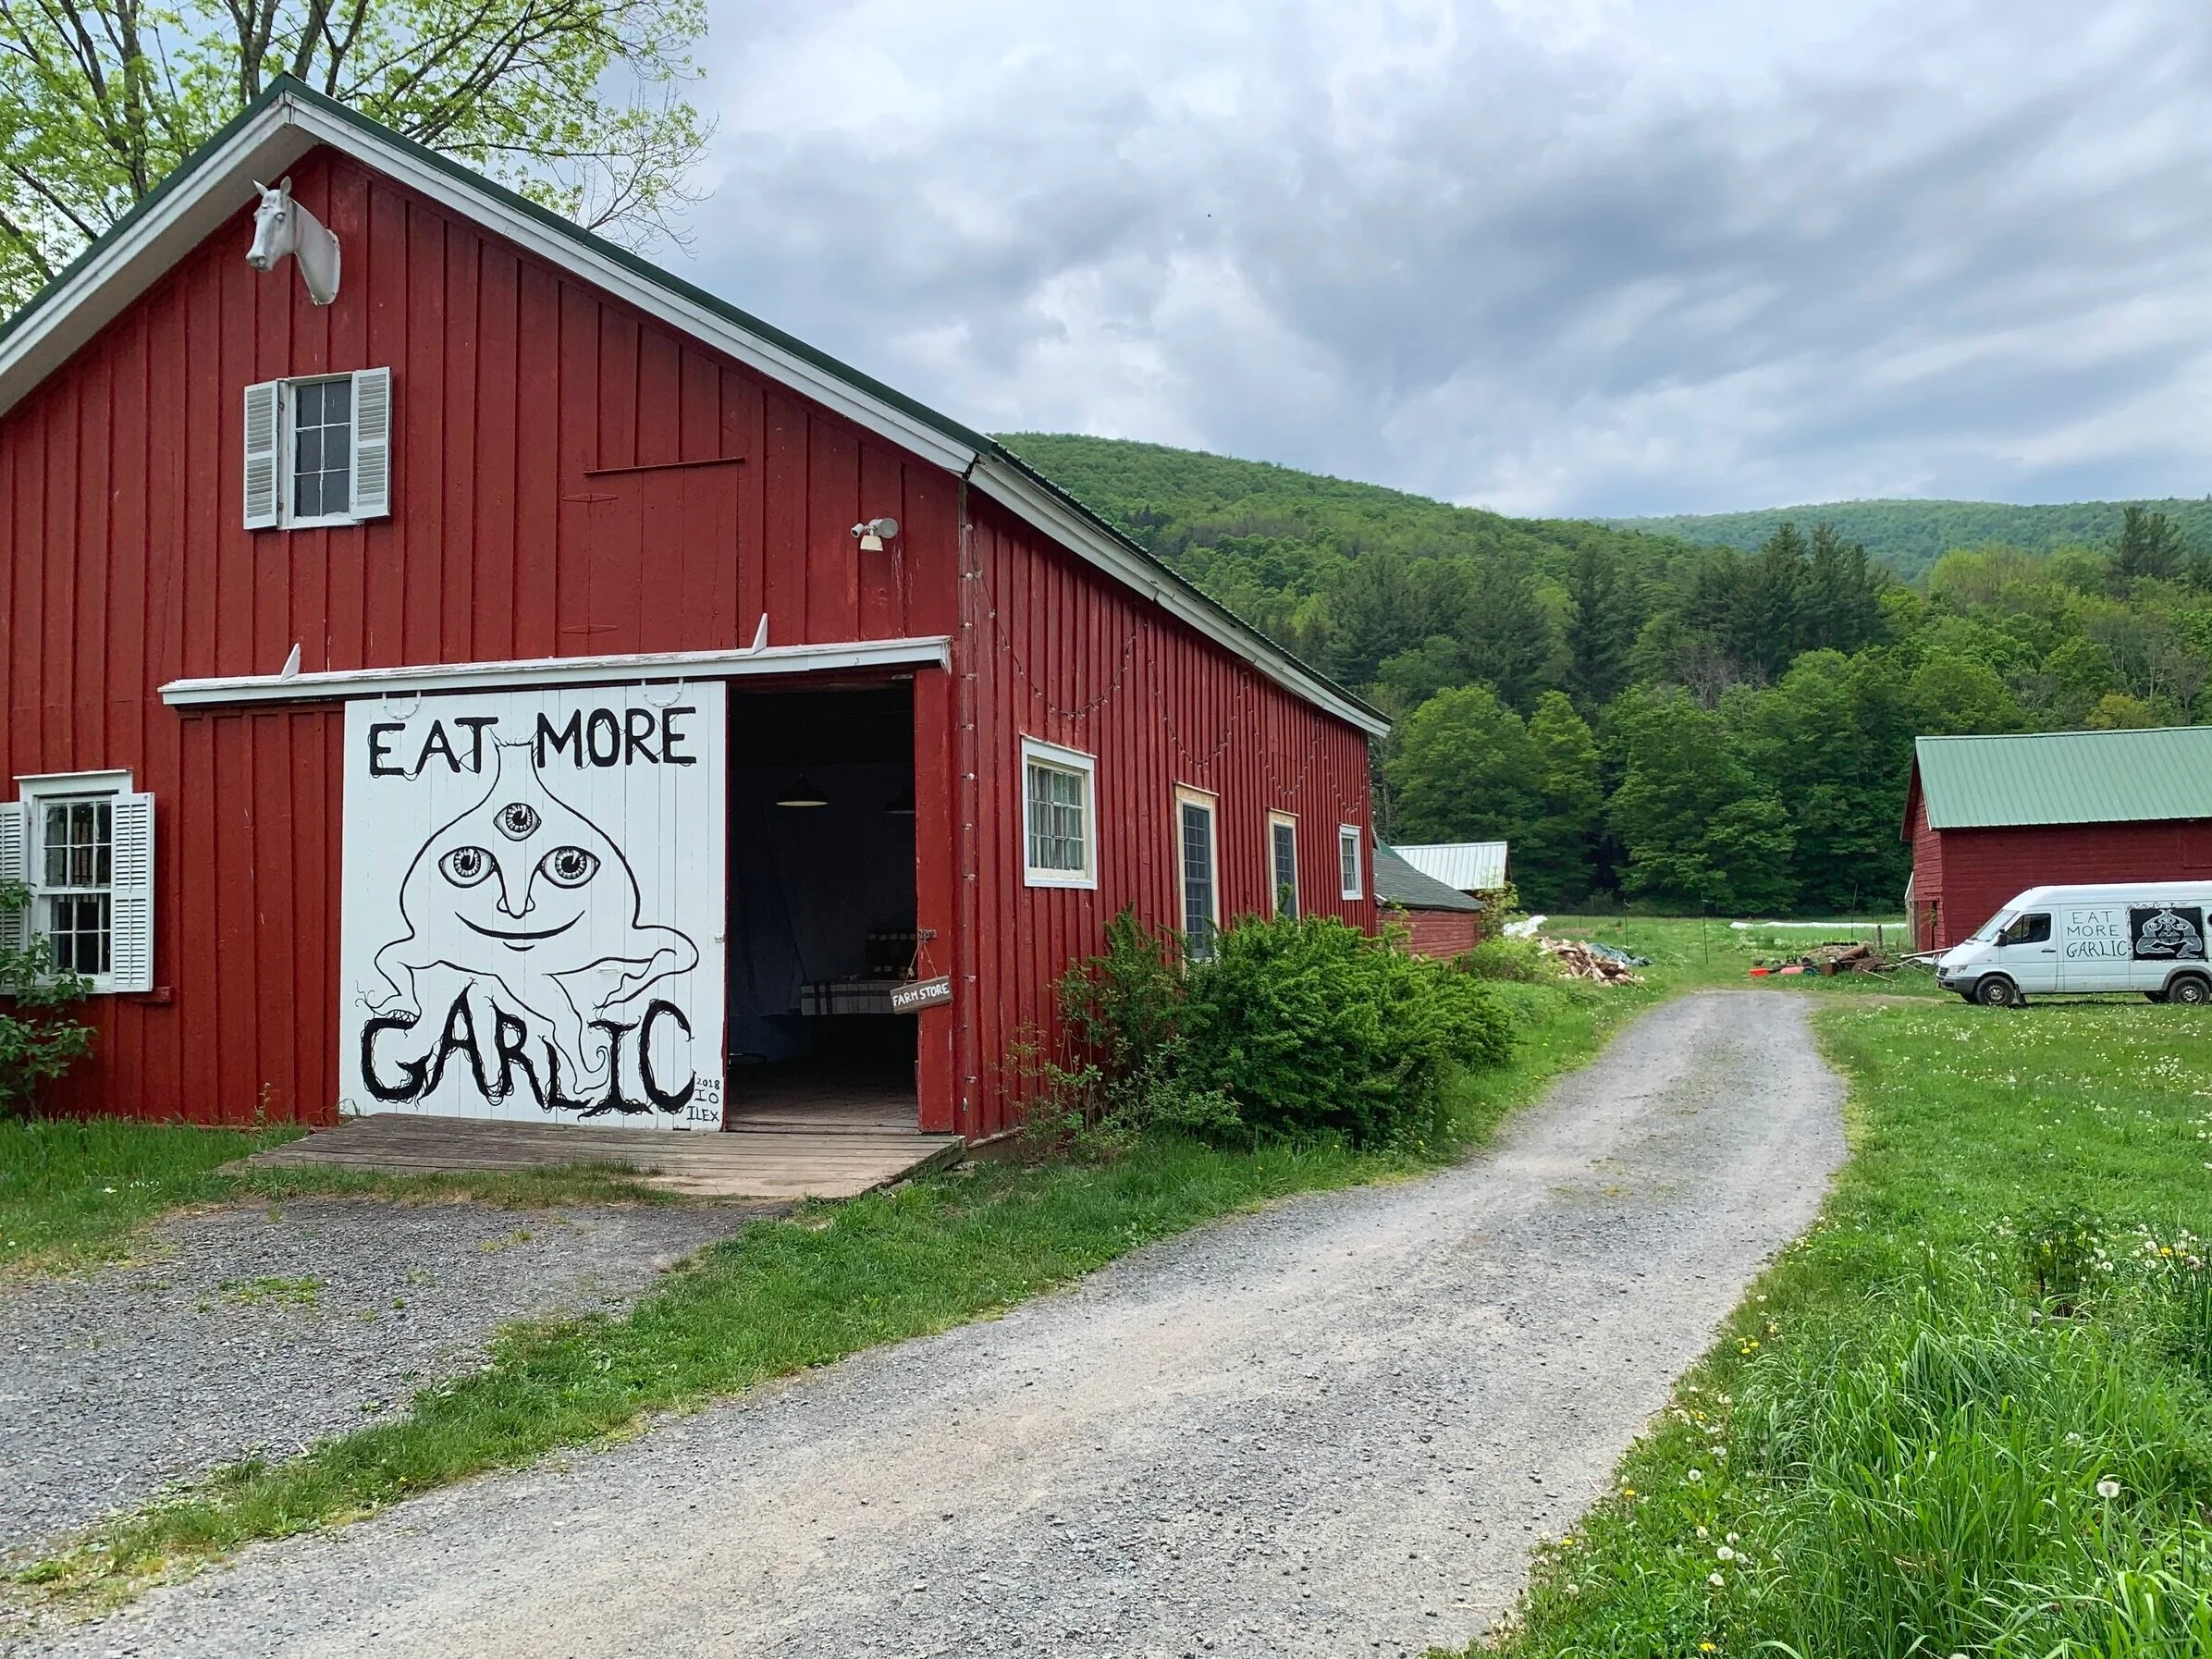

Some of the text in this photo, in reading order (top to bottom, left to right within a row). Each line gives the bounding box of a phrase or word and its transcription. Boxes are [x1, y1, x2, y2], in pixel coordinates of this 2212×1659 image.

[369, 707, 696, 776] EAT MORE
[2071, 911, 2113, 924] EAT
[2067, 925, 2120, 937] MORE
[2066, 940, 2128, 958] GARLIC
[892, 982, 951, 1007] FARM STORE
[361, 979, 696, 1118] GARLIC
[696, 1078, 720, 1090] 2018
[686, 1105, 720, 1122] ILEX
